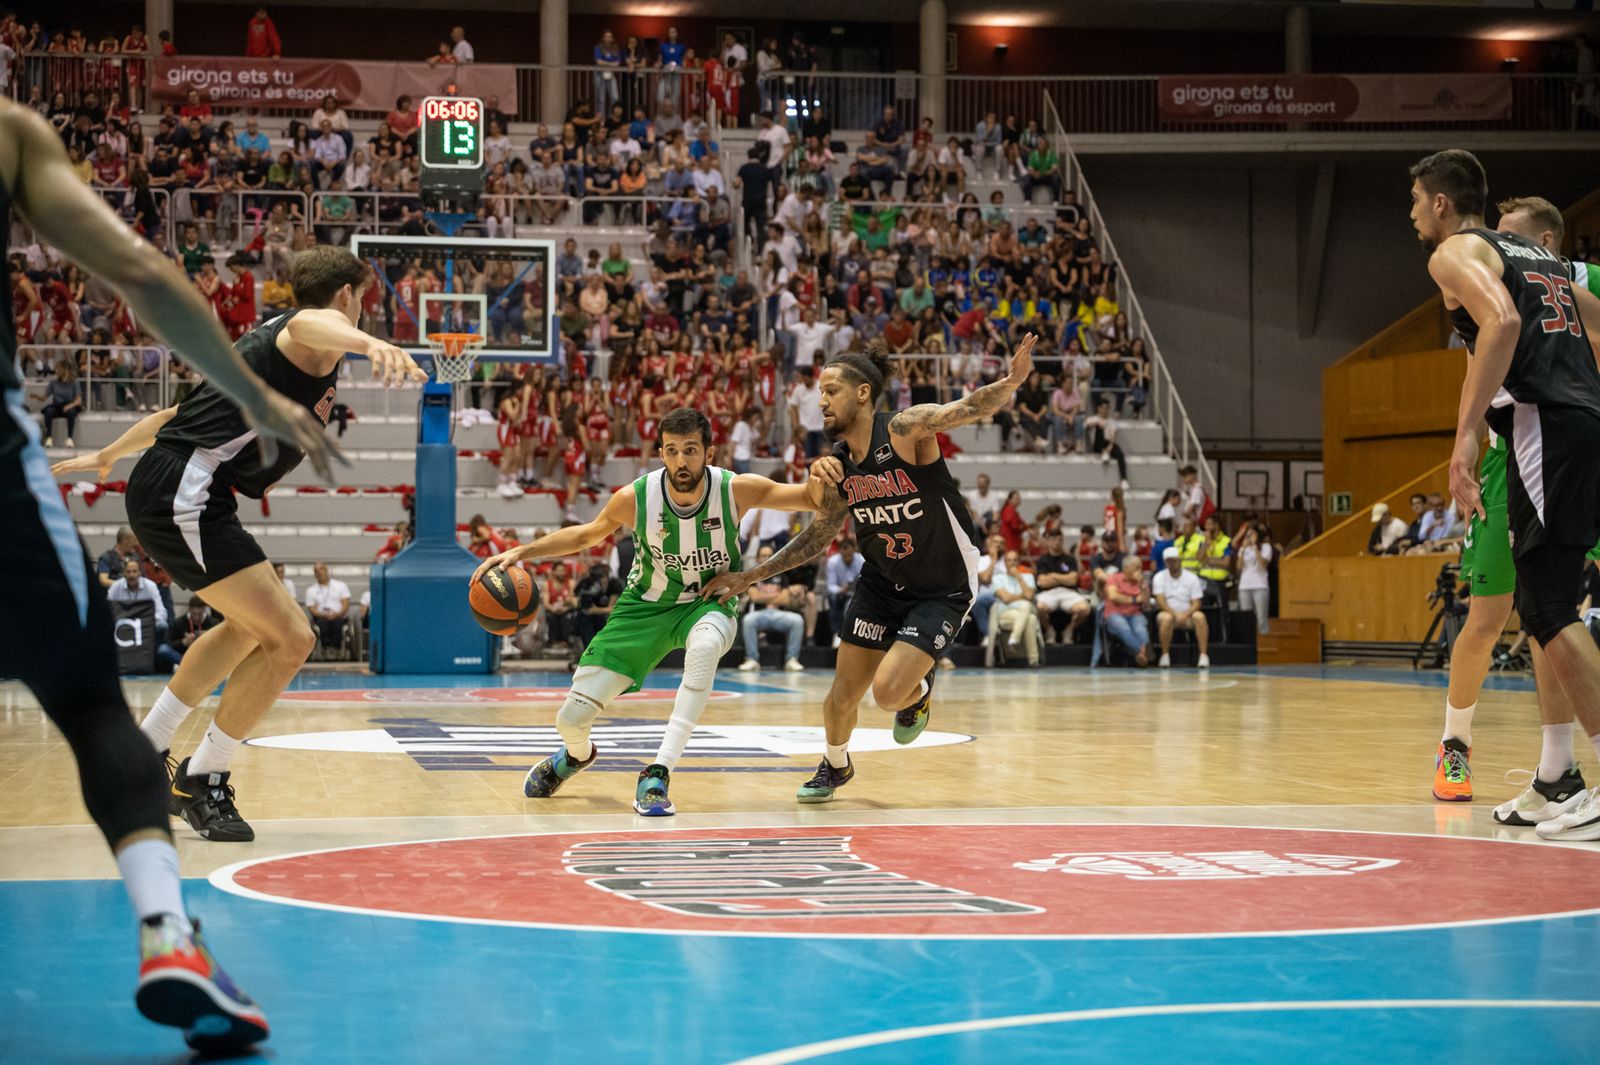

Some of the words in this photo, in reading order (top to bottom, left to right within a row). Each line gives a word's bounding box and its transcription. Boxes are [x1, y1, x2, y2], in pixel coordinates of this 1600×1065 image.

[167, 66, 231, 89] girona
[238, 69, 268, 84] ets
[273, 69, 294, 85] tu
[209, 86, 260, 100] girona
[287, 87, 338, 102] esport
[1173, 84, 1235, 107] girona
[1240, 85, 1269, 100] ets
[1274, 85, 1294, 100] tu
[426, 99, 479, 120] 06:06
[1213, 101, 1263, 117] girona
[1287, 101, 1336, 116] esport
[443, 120, 475, 155] 13
[1522, 271, 1582, 337] 35
[853, 497, 925, 525] FIATC
[877, 532, 915, 560] 23
[852, 617, 887, 642] YOSOY
